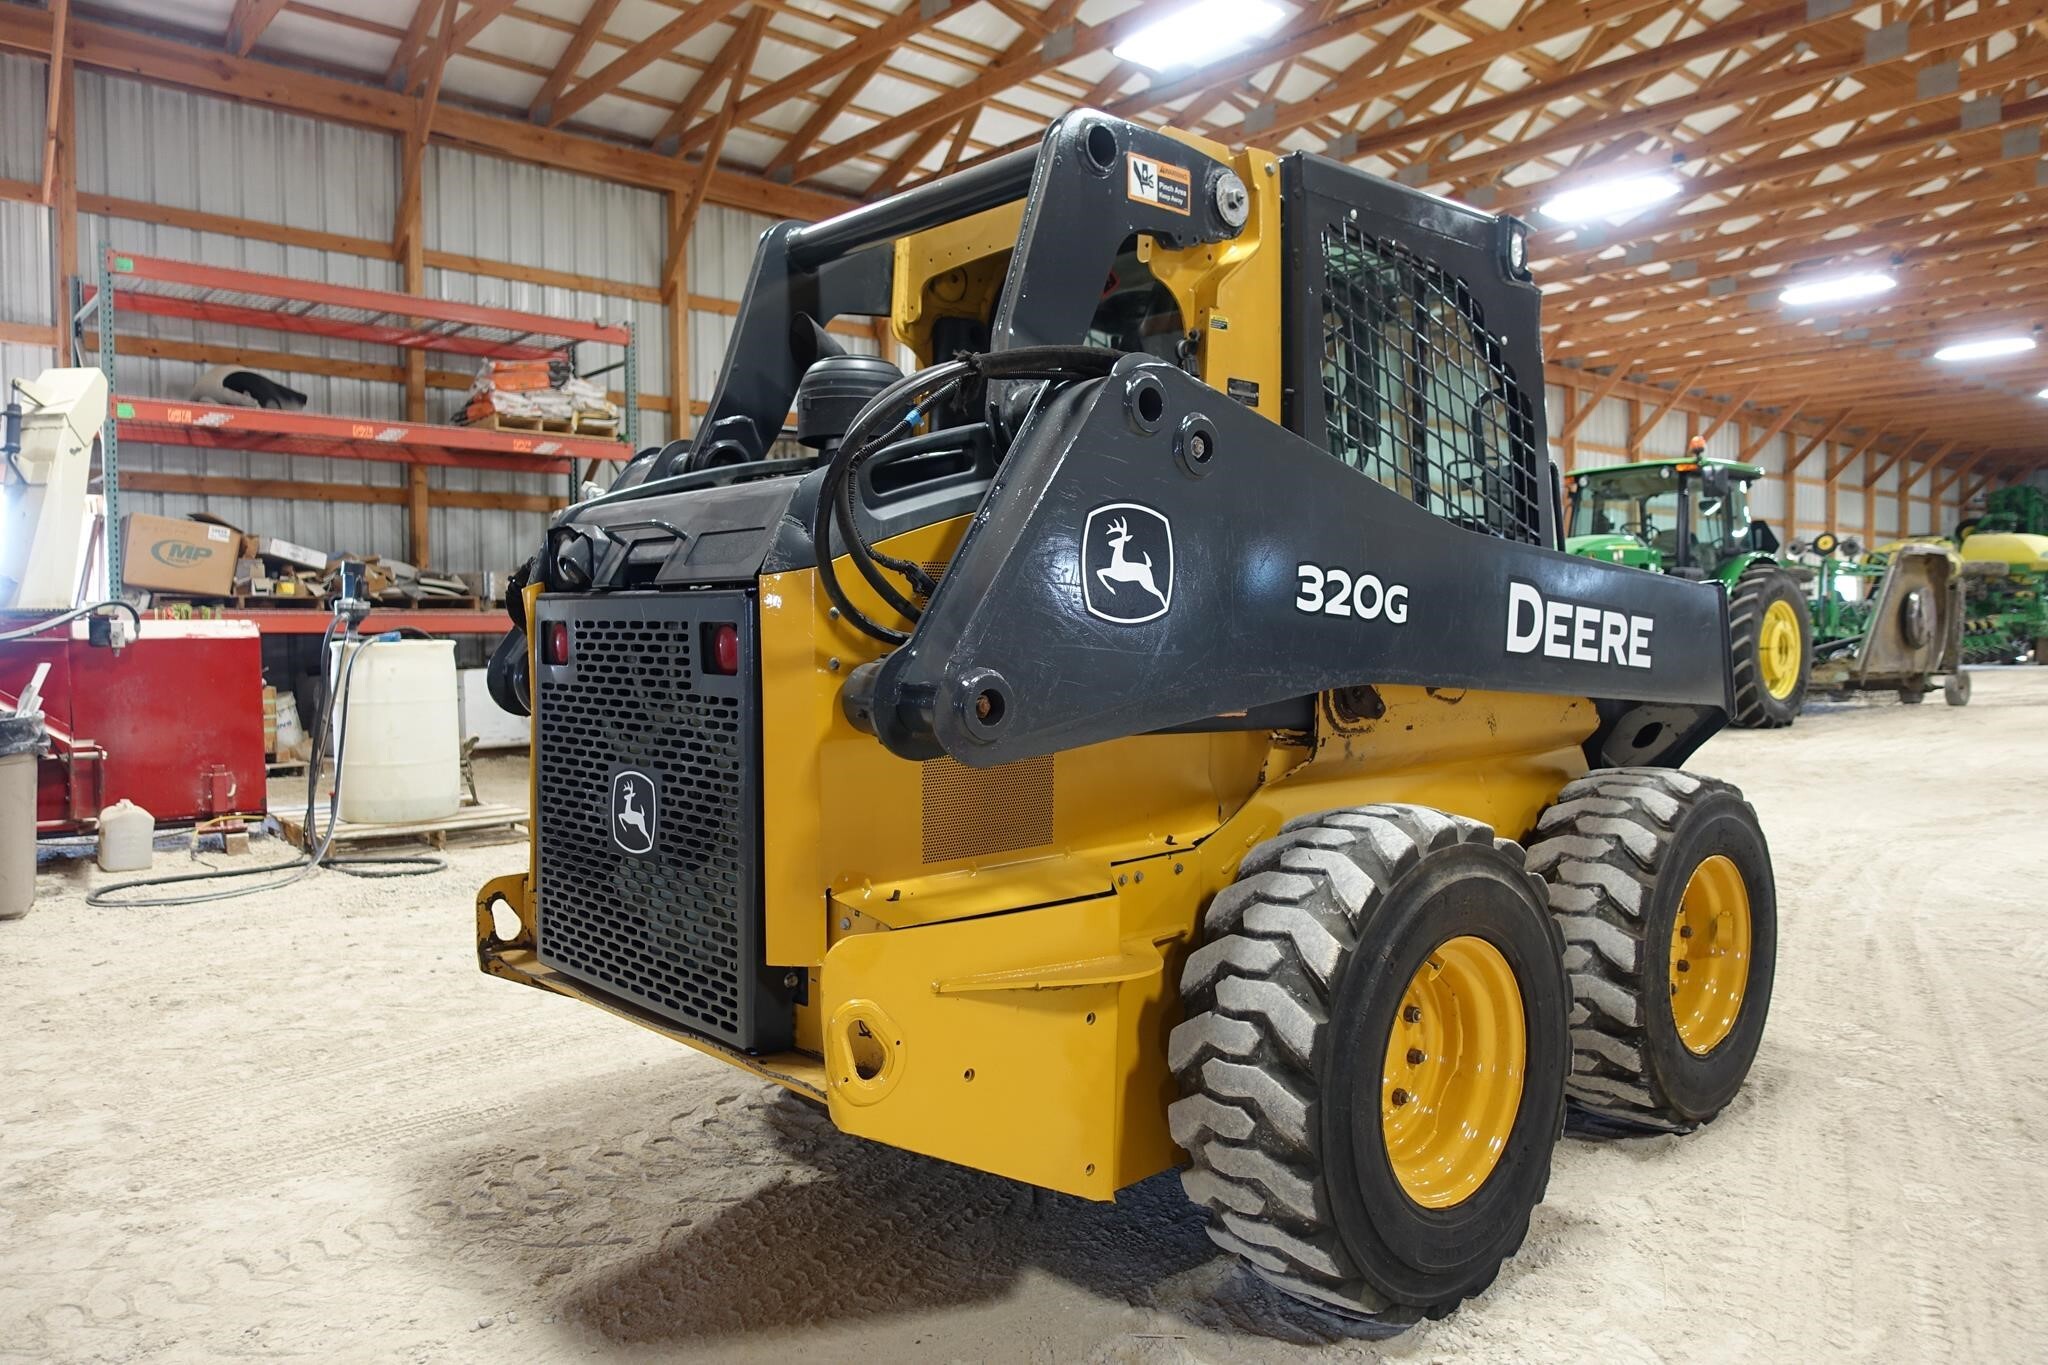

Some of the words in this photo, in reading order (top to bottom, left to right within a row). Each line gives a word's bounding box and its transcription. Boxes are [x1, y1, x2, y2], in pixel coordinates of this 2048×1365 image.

[1159, 181, 1174, 193] Pinch
[1174, 187, 1187, 197] Area
[1296, 564, 1409, 624] 320G
[1506, 581, 1654, 669] DEERE
